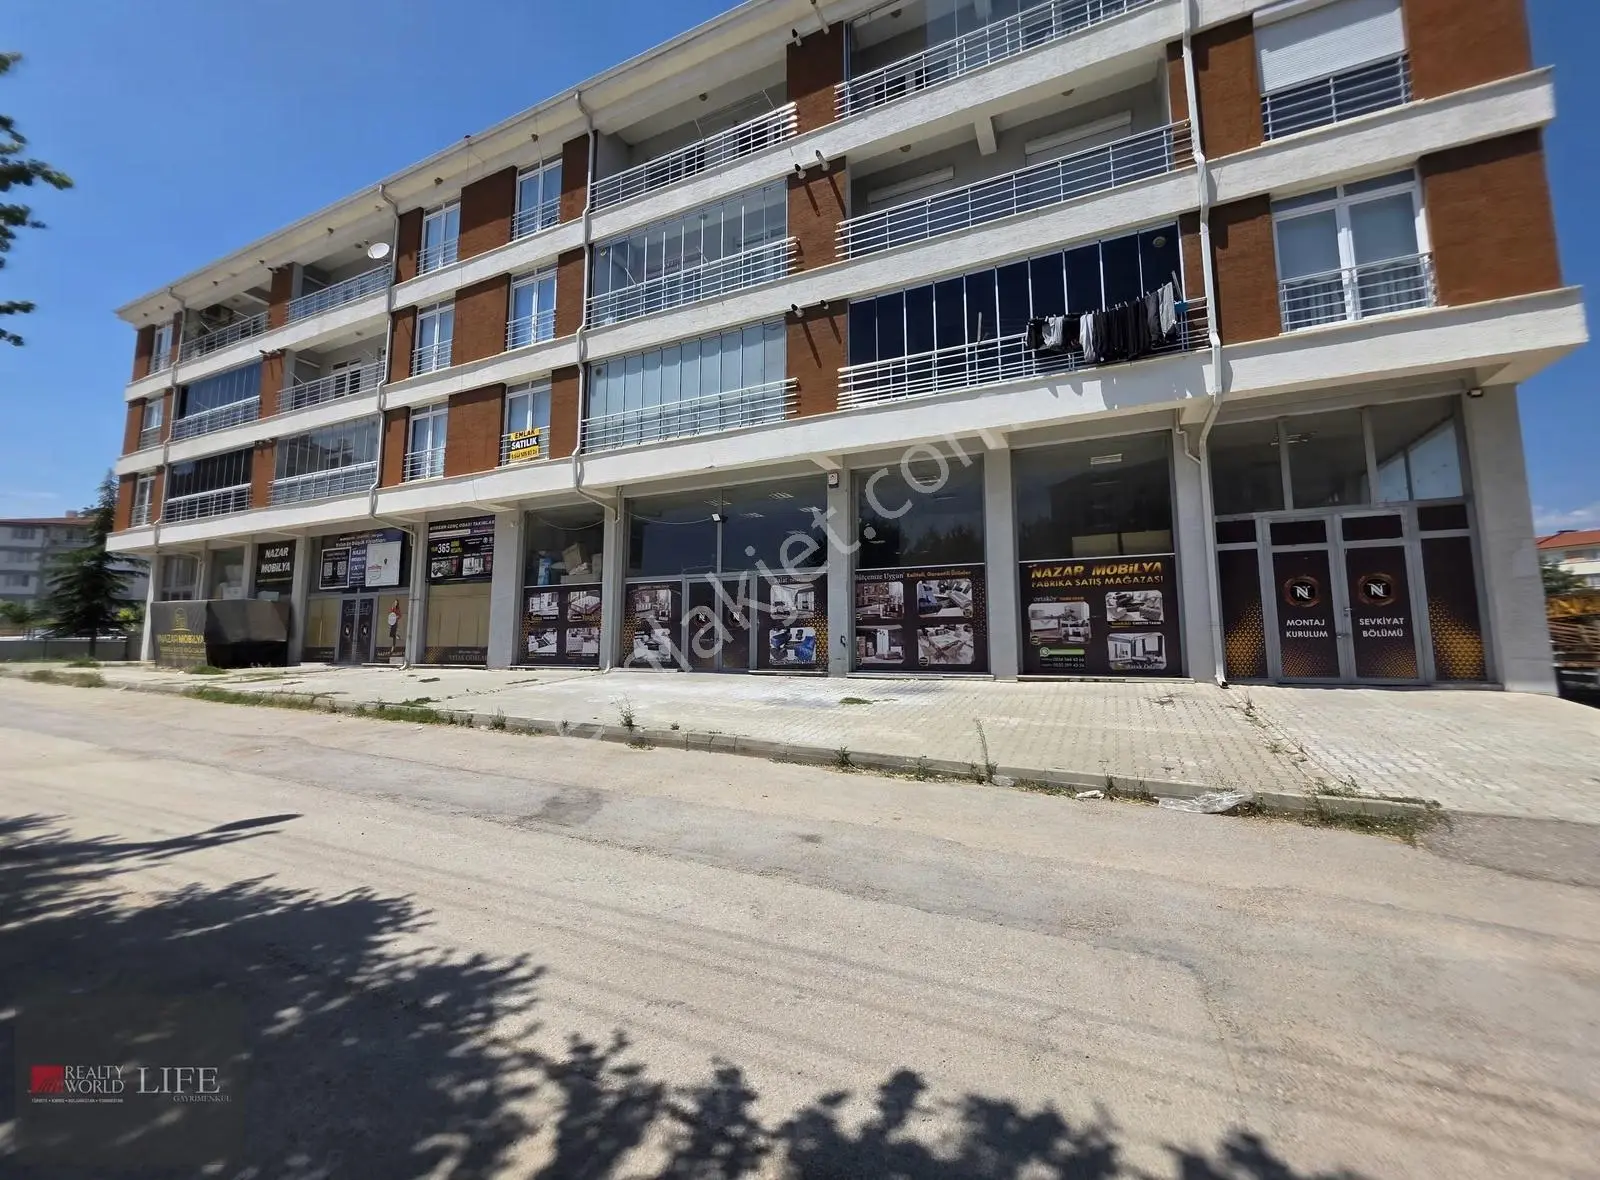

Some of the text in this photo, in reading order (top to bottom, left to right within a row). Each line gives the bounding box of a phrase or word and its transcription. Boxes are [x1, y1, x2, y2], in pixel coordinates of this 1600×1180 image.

[515, 430, 535, 439] EMLAK
[511, 437, 537, 450] SATILIK
[265, 547, 289, 559] NAZAR
[437, 543, 450, 553] 365
[1031, 565, 1085, 578] NAZAR
[1104, 575, 1164, 585] MAĞAZASI
[1286, 619, 1325, 627] MONTAJ
[1359, 616, 1404, 626] SEVKİYAT
[1286, 630, 1328, 638] KURULUM
[1362, 628, 1403, 638] BÖLÜMÜ
